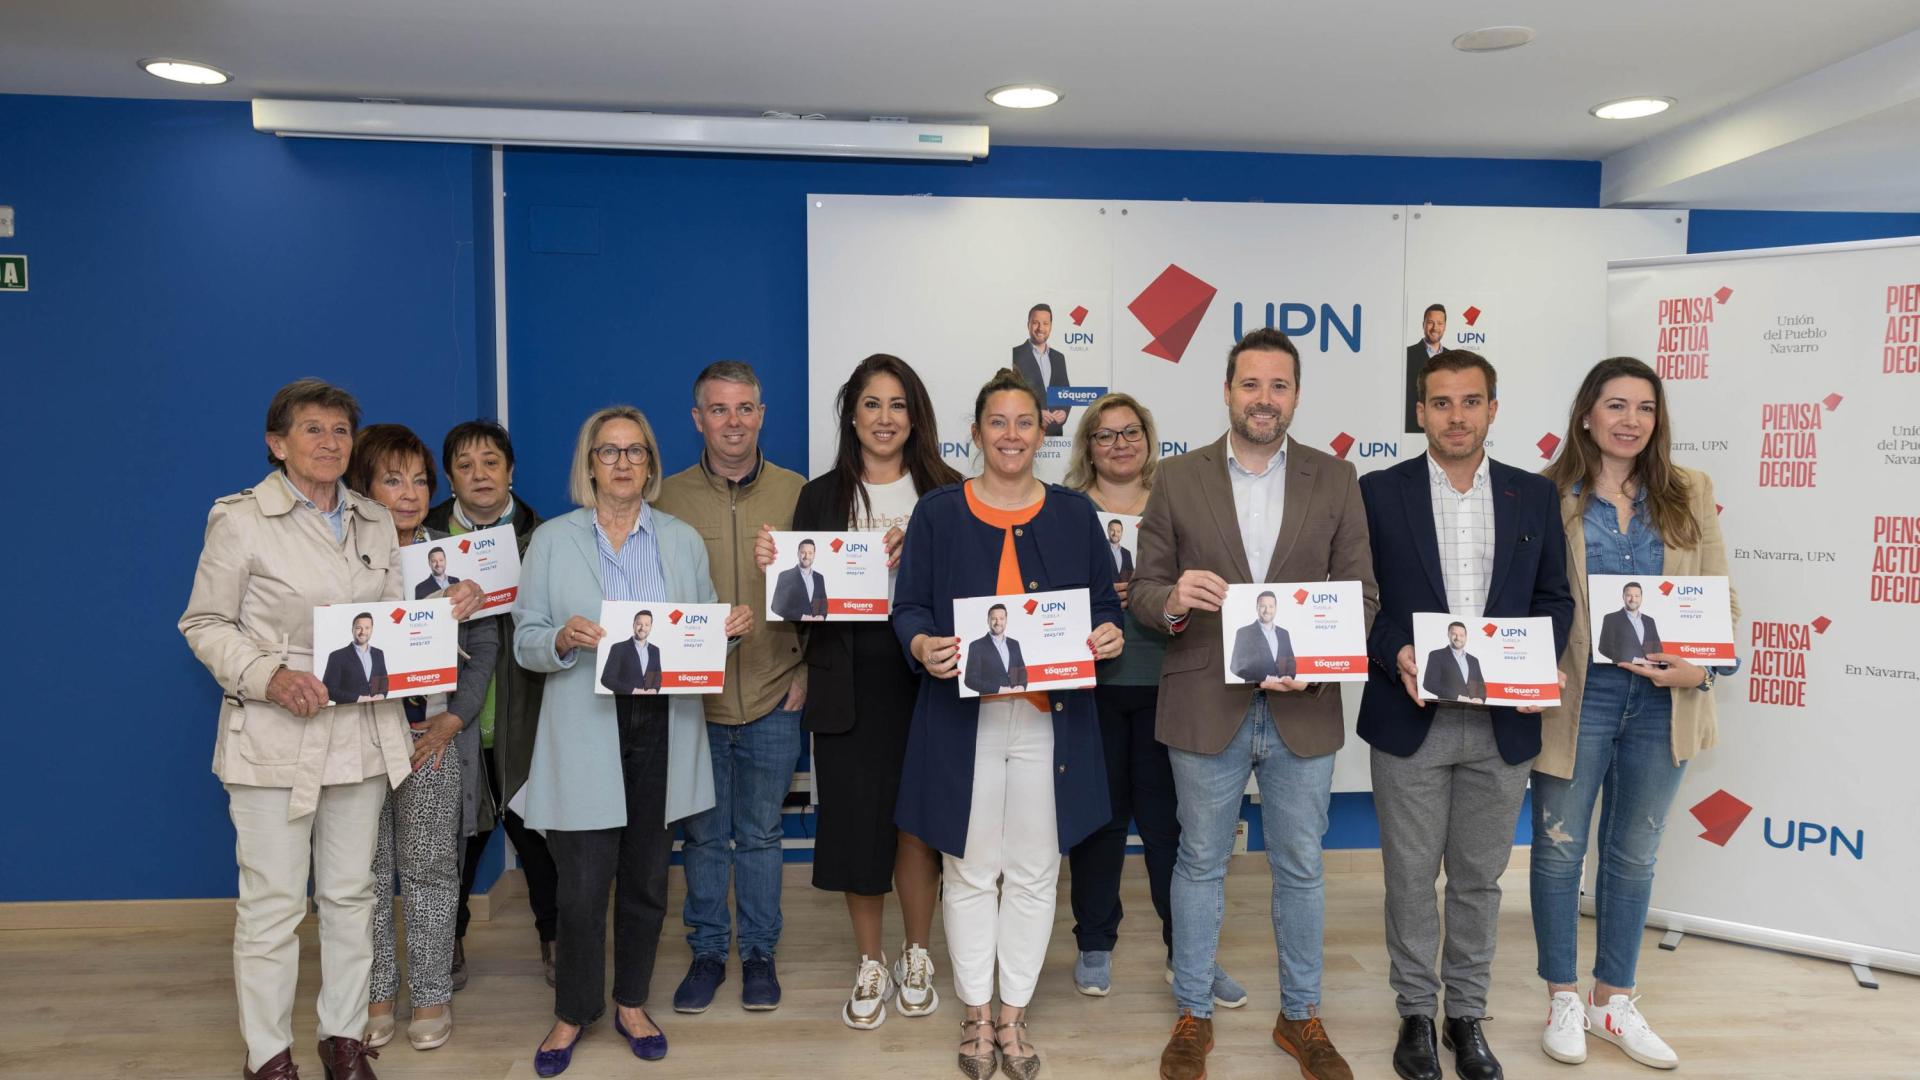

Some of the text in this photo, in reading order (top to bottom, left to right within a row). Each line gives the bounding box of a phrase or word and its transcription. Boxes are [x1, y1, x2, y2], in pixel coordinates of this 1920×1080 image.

[1658, 297, 1714, 325] PIENSA
[1777, 314, 1815, 326] Unión
[1233, 302, 1362, 353] UPN
[1763, 328, 1827, 340] del Pueblo
[1064, 333, 1094, 344] UPN
[1457, 333, 1485, 344] UPN
[1657, 323, 1709, 352] ACTÚA
[1769, 344, 1819, 354] Navarro
[1656, 353, 1709, 380] DECIDE
[1762, 403, 1822, 430] PIENSA
[1158, 441, 1188, 457] PN
[1359, 442, 1397, 458] UPN
[1702, 440, 1729, 451] UPN
[1761, 430, 1817, 459] ACTÚA
[1877, 439, 1897, 451] del
[1032, 451, 1061, 459] avarra
[1759, 461, 1817, 488] DECIDE
[473, 538, 496, 551] UPN
[846, 543, 868, 553] UPN
[1734, 548, 1837, 562] En Navarra, UPN
[1677, 586, 1704, 595] UPN
[1312, 593, 1338, 604] UPN
[1041, 602, 1066, 613] UPN
[408, 610, 434, 621] UPN
[685, 615, 708, 625] UPN
[1501, 628, 1527, 637] UPN
[1752, 621, 1811, 651] PIENSA
[1750, 649, 1806, 679] ACTÚA
[1845, 664, 1920, 681] En Navarra,
[1749, 677, 1806, 707] DECIDE
[1764, 817, 1864, 860] UPN
